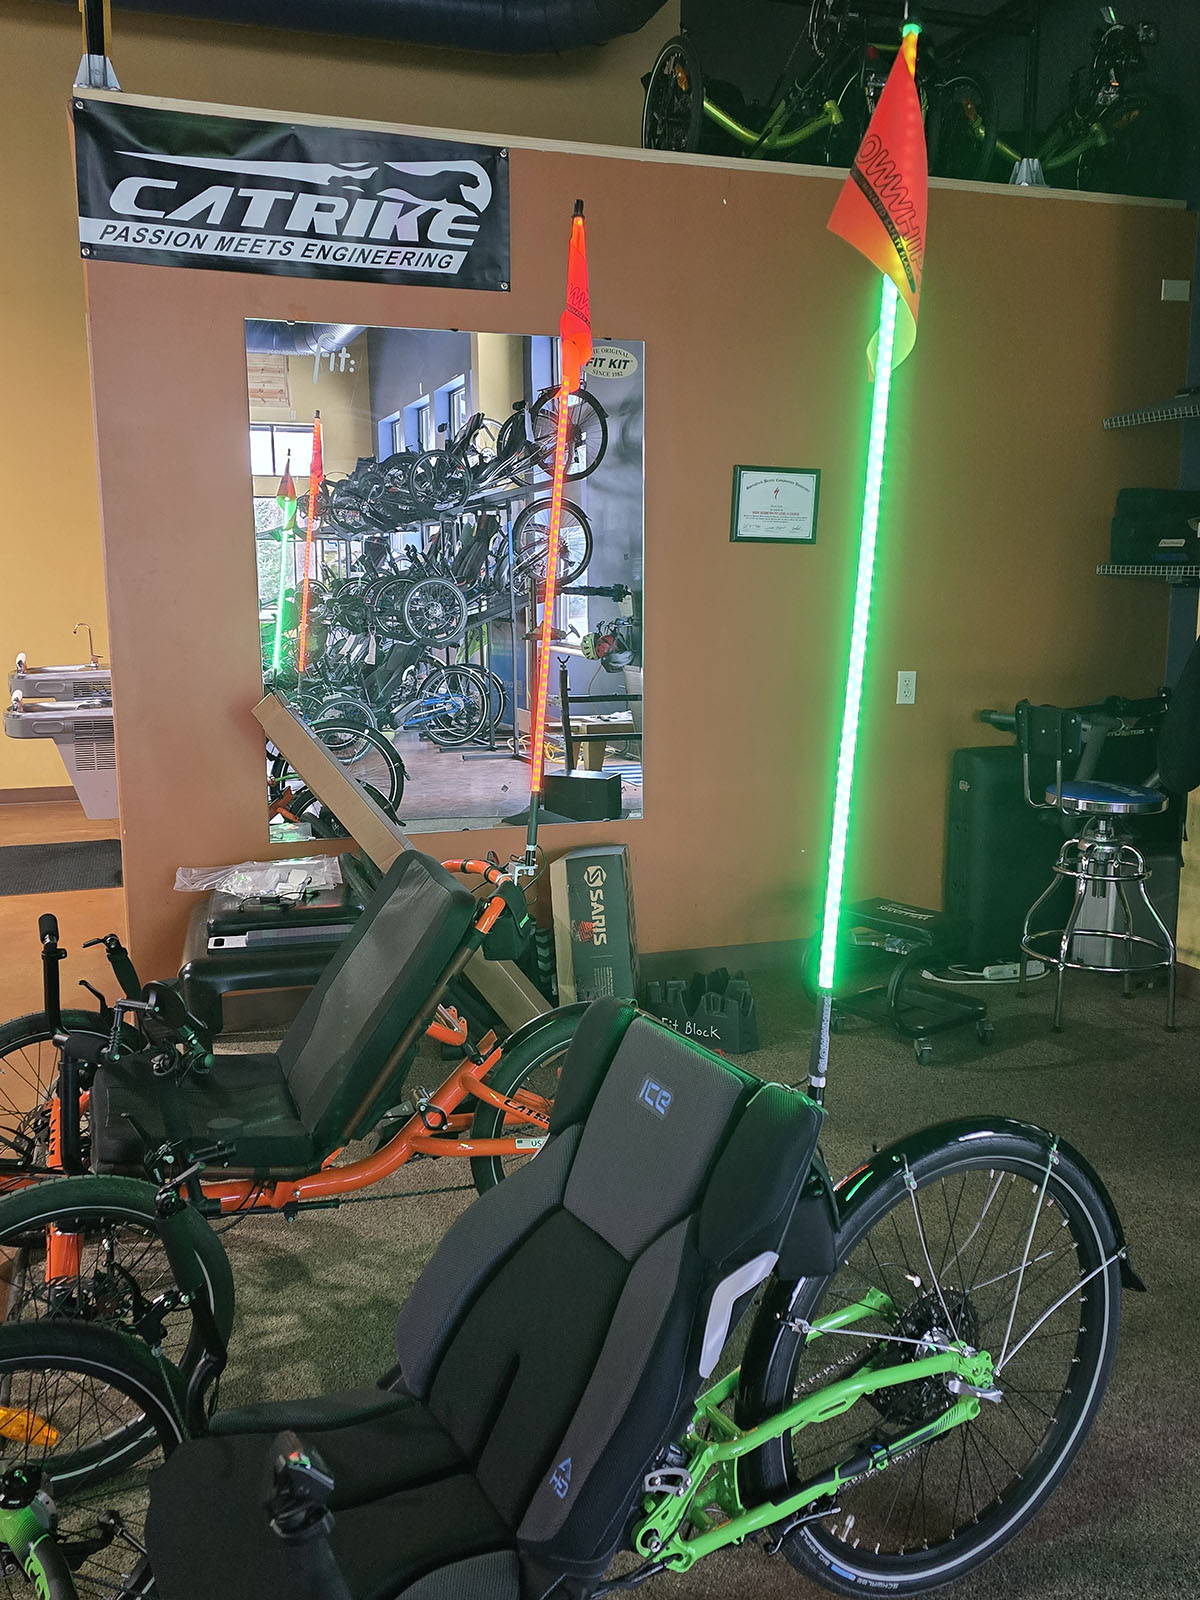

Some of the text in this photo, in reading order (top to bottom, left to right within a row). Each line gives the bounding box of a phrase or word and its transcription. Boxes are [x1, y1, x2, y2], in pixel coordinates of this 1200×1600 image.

[109, 176, 481, 246] CATRIKE
[99, 224, 454, 269] PASSION MEETS ENGINEERING
[883, 214, 903, 249] SAFETY
[585, 357, 630, 370] FIT KIT
[601, 347, 630, 358] ORIGINAL
[591, 369, 611, 377] SINCE
[589, 888, 608, 946] SARIS
